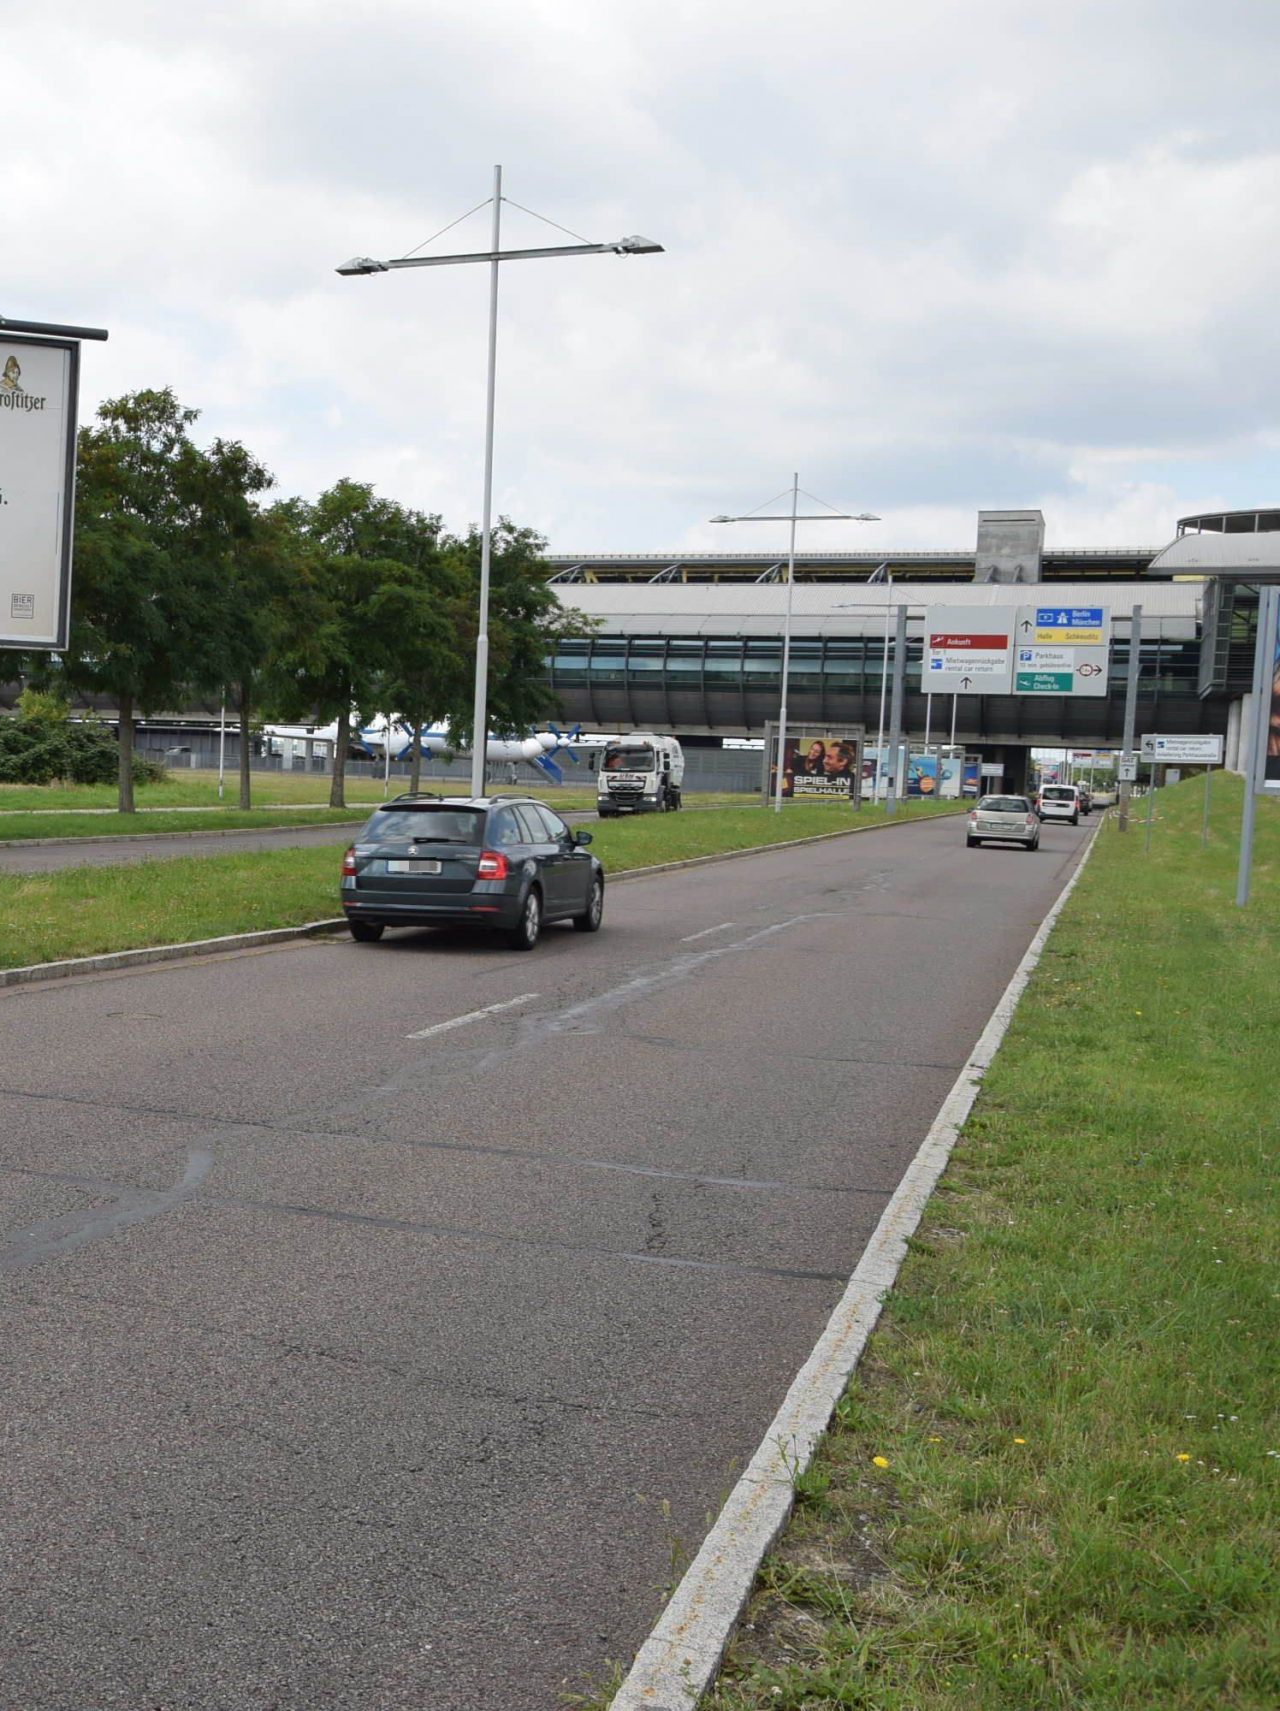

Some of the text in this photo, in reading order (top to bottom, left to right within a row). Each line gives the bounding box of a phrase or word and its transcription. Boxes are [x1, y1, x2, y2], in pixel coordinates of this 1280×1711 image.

[1071, 610, 1091, 618] Berlin
[1071, 618, 1100, 626] München
[1037, 632, 1053, 640] Halle
[946, 638, 972, 646] Ankunft
[1034, 674, 1055, 683] Abflug
[793, 775, 851, 785] SPIEL-IN
[793, 786, 850, 794] SPIELHALLE
